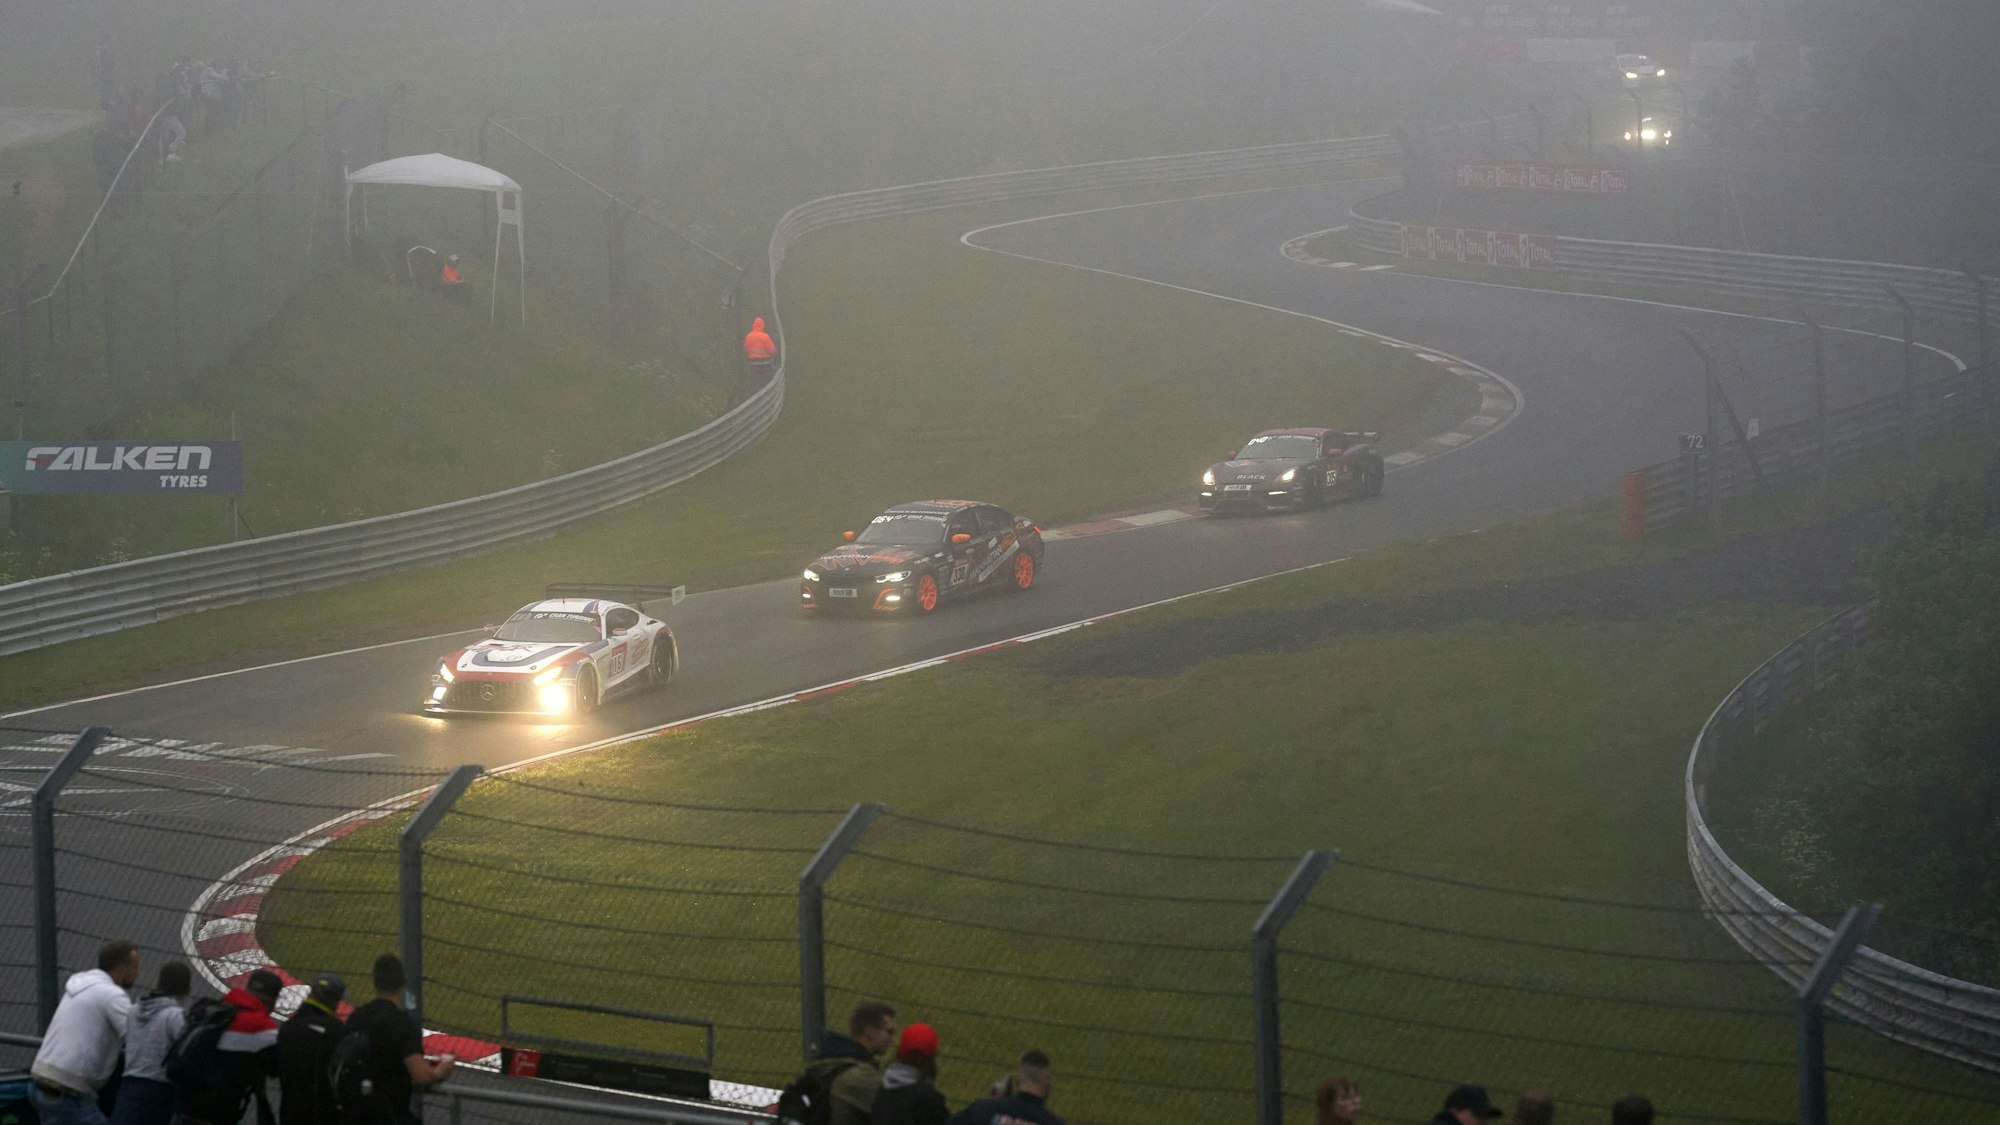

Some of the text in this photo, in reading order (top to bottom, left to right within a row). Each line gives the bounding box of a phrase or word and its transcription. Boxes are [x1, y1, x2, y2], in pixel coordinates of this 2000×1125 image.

[1466, 238, 1487, 256] TOTAL
[1496, 240, 1519, 259] TOTAL
[1687, 435, 1704, 449] 72
[24, 446, 212, 471] FALKEN
[160, 475, 208, 488] TYRES
[613, 653, 623, 673] 16
